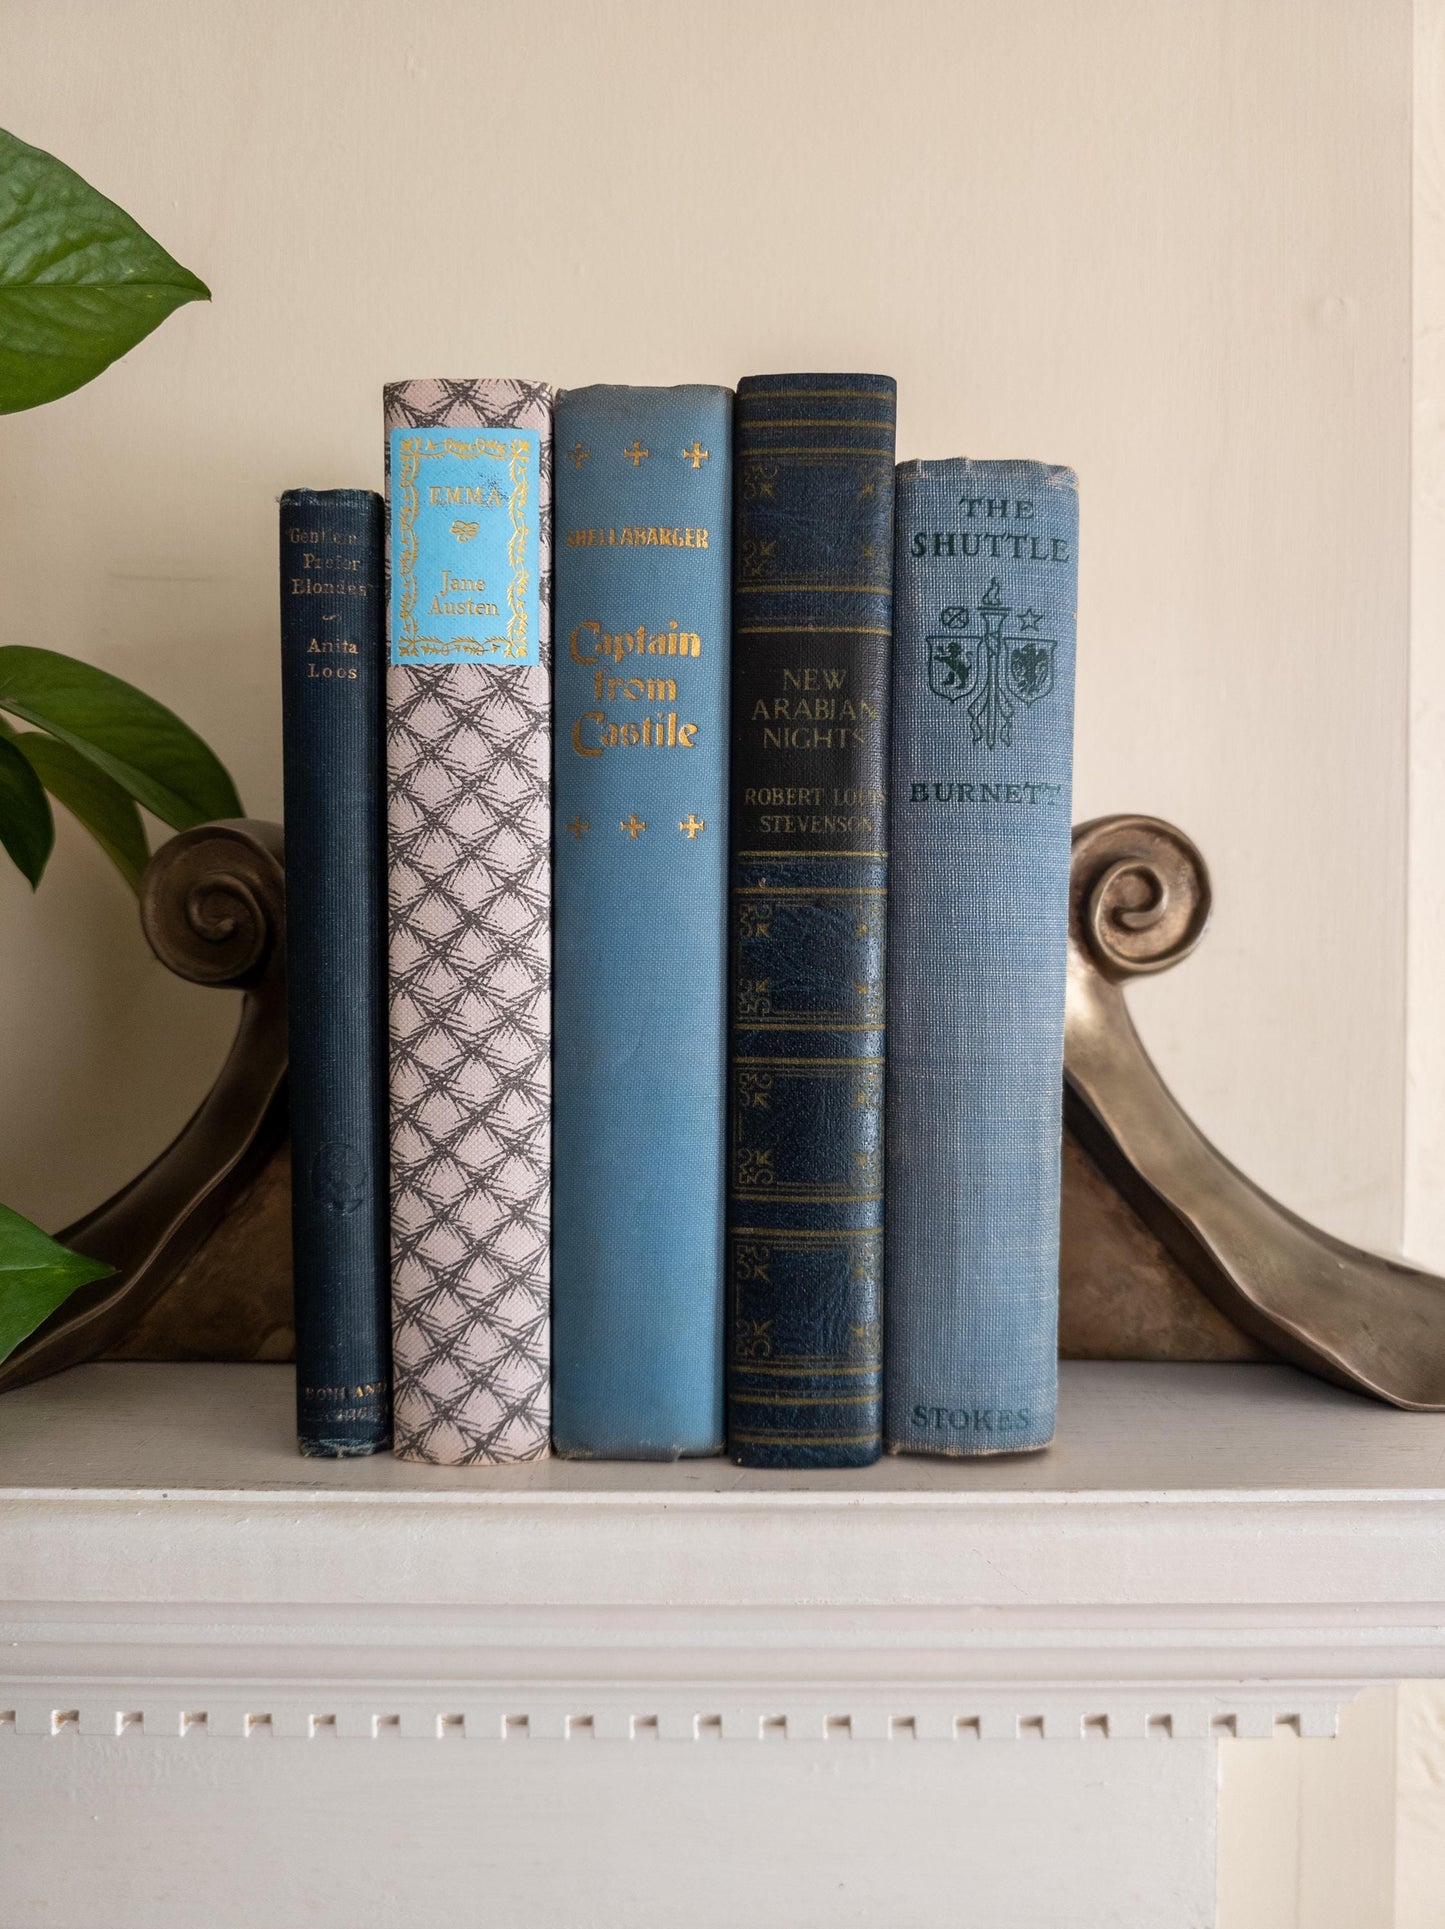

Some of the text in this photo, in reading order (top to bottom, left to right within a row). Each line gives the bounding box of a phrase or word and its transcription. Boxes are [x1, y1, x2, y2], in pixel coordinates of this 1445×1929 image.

[429, 485, 502, 506] EMMA
[959, 498, 1035, 520] THE
[911, 531, 1071, 564] SHUTTLE
[440, 570, 487, 597] Jane
[427, 596, 499, 617] Austen
[569, 619, 702, 664] Captain
[594, 666, 678, 702] from
[783, 667, 847, 692] NEW
[751, 698, 878, 722] ARABIAN
[571, 711, 699, 758] Castile
[744, 787, 824, 807] ROBERT
[908, 781, 1062, 806] BURNETT
[911, 1404, 1030, 1433] STOKES
